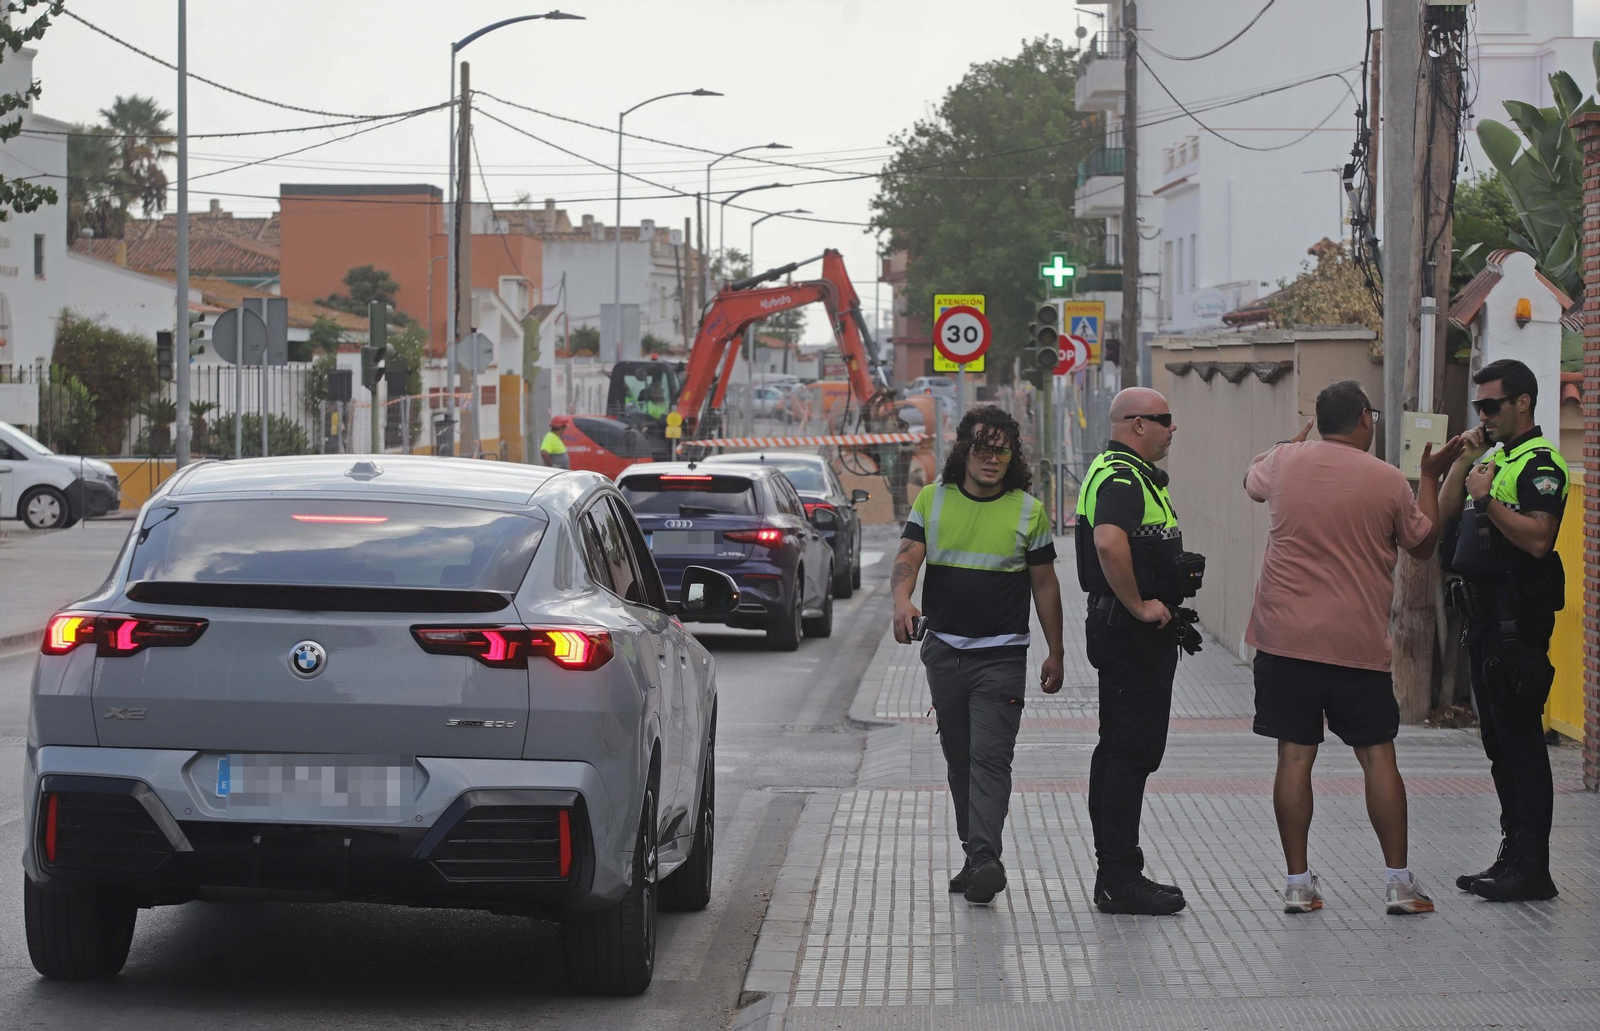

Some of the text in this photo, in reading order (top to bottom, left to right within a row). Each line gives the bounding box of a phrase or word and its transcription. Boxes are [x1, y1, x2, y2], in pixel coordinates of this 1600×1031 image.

[760, 295, 792, 309] Kubota
[937, 297, 983, 306] ATENCIÓN
[947, 325, 978, 343] 30
[1059, 349, 1075, 360] OP
[295, 645, 320, 656] BMW
[103, 707, 147, 720] X2
